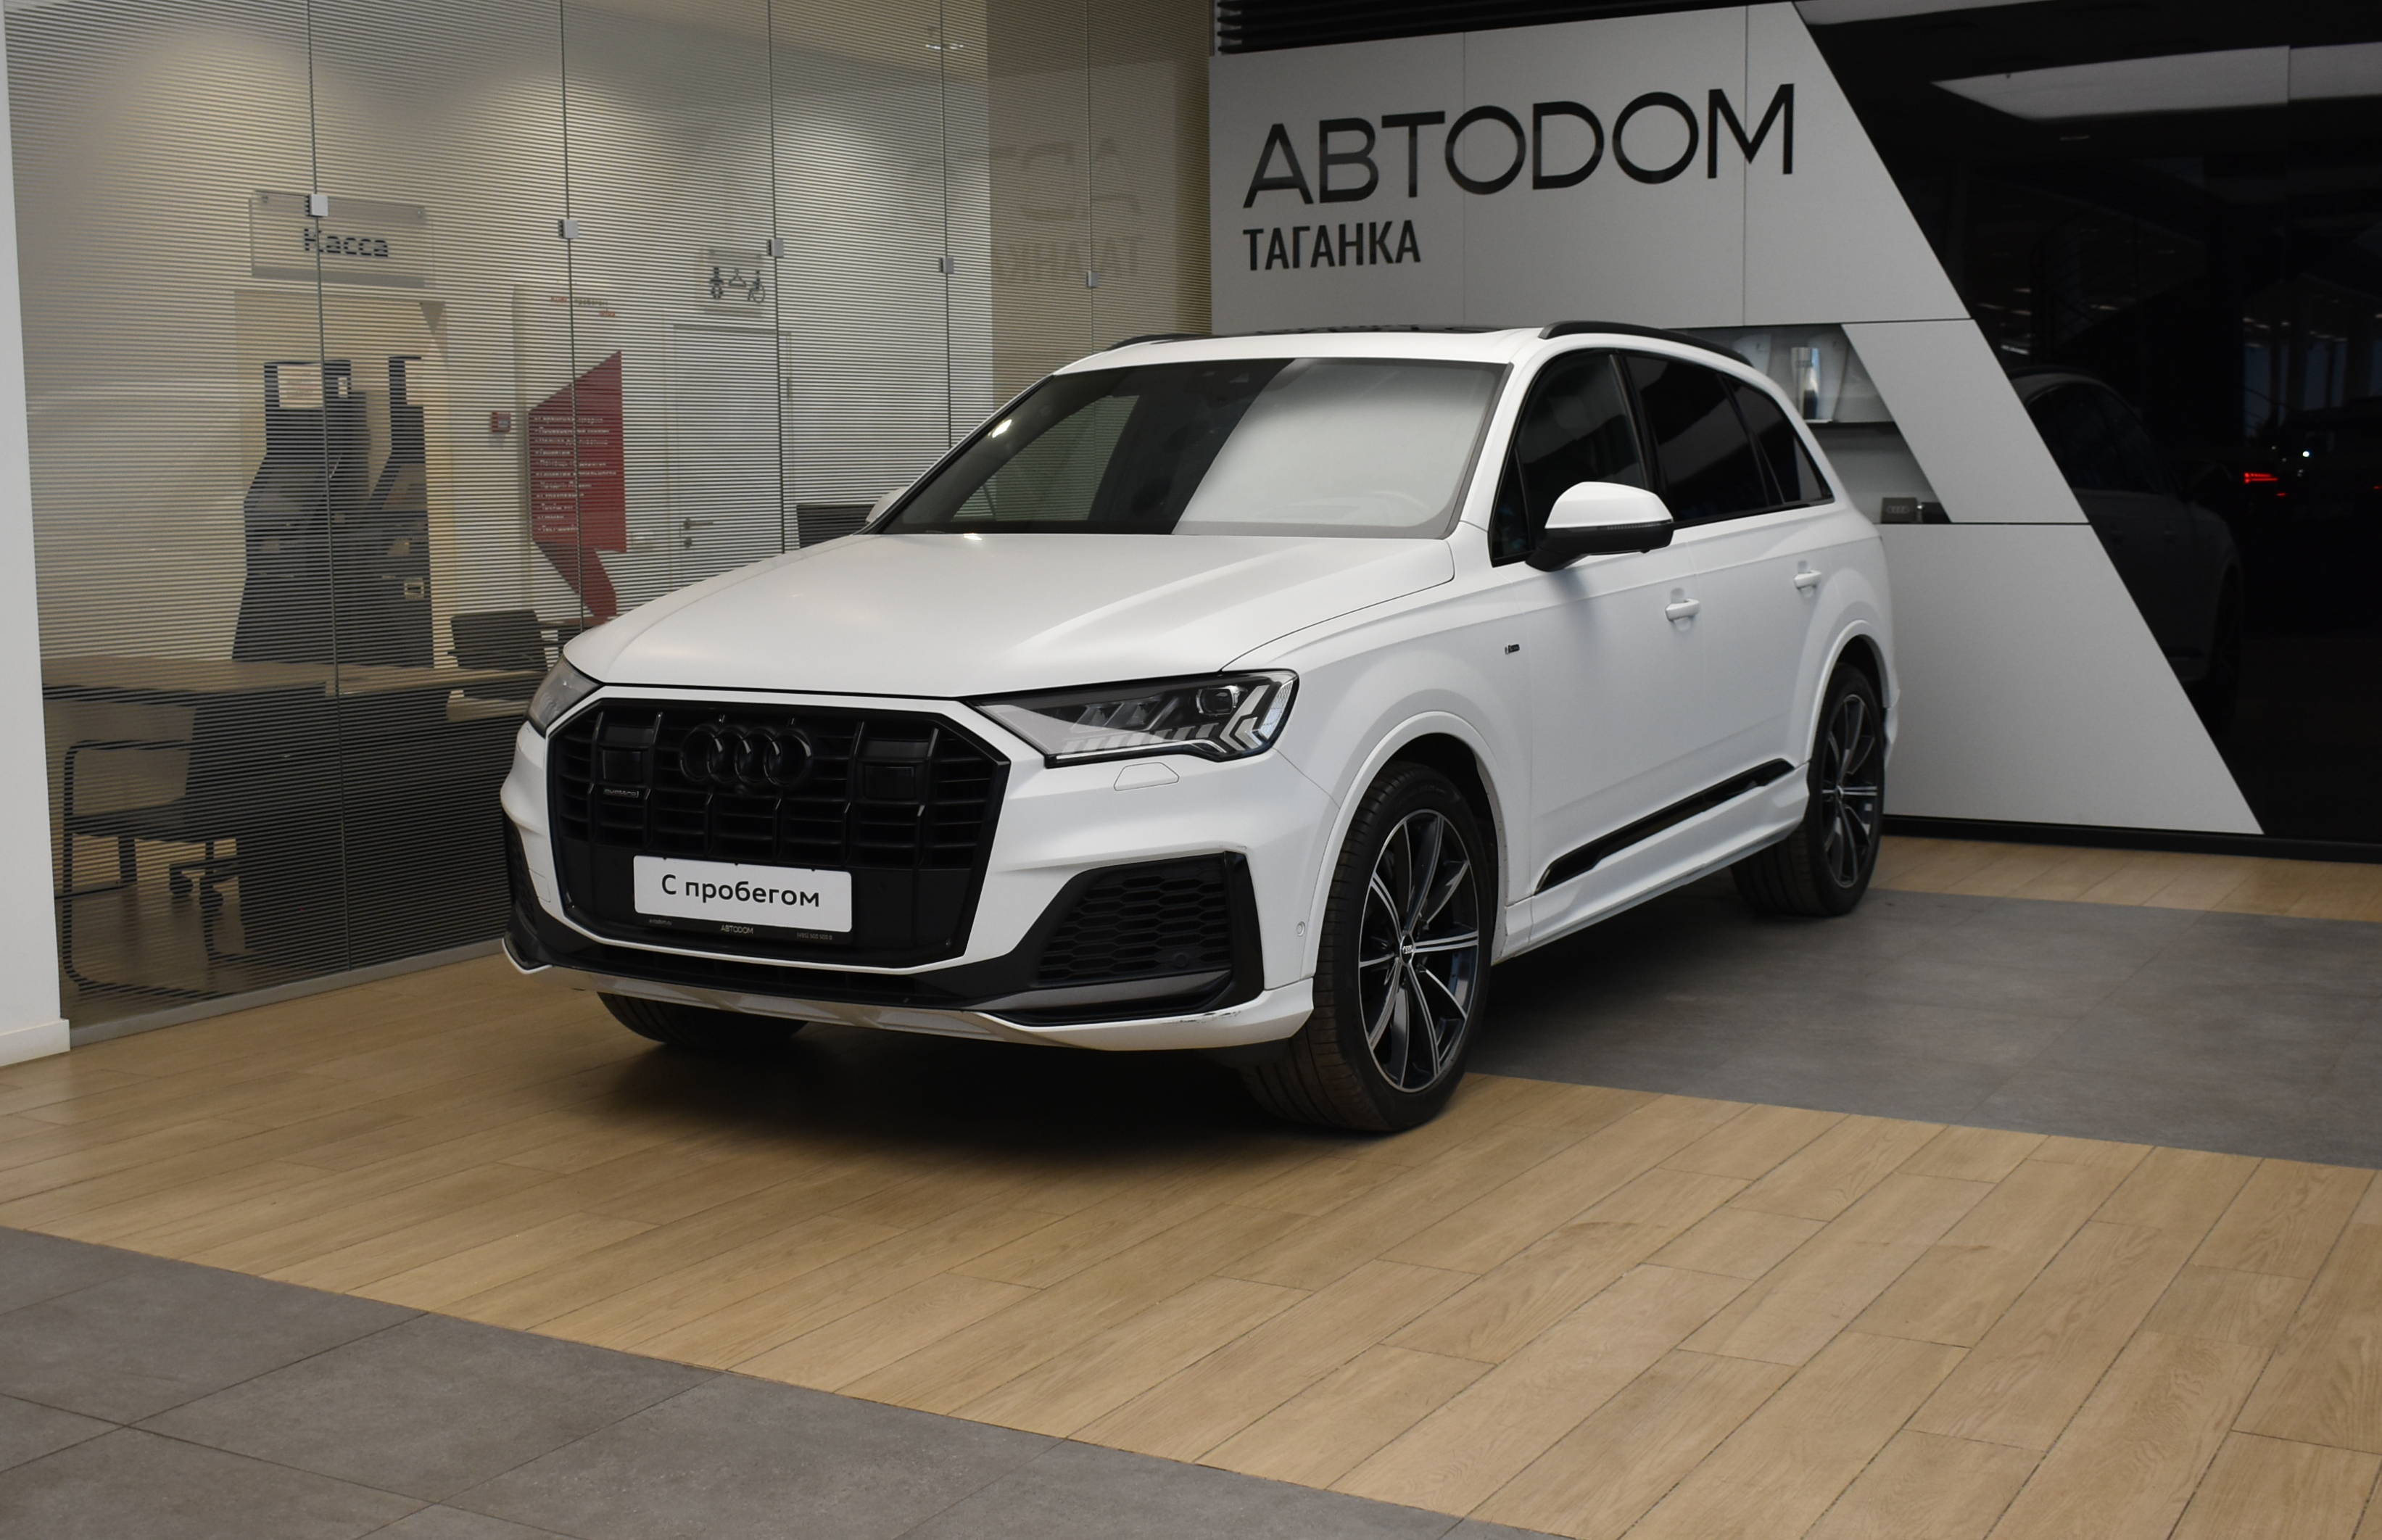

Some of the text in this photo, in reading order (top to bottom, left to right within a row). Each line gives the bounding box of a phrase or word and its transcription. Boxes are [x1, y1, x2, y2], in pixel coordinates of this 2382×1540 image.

[304, 228, 389, 257] Касса
[1243, 220, 1421, 271] ТАГАНКА
[661, 874, 820, 908] С пробегом
